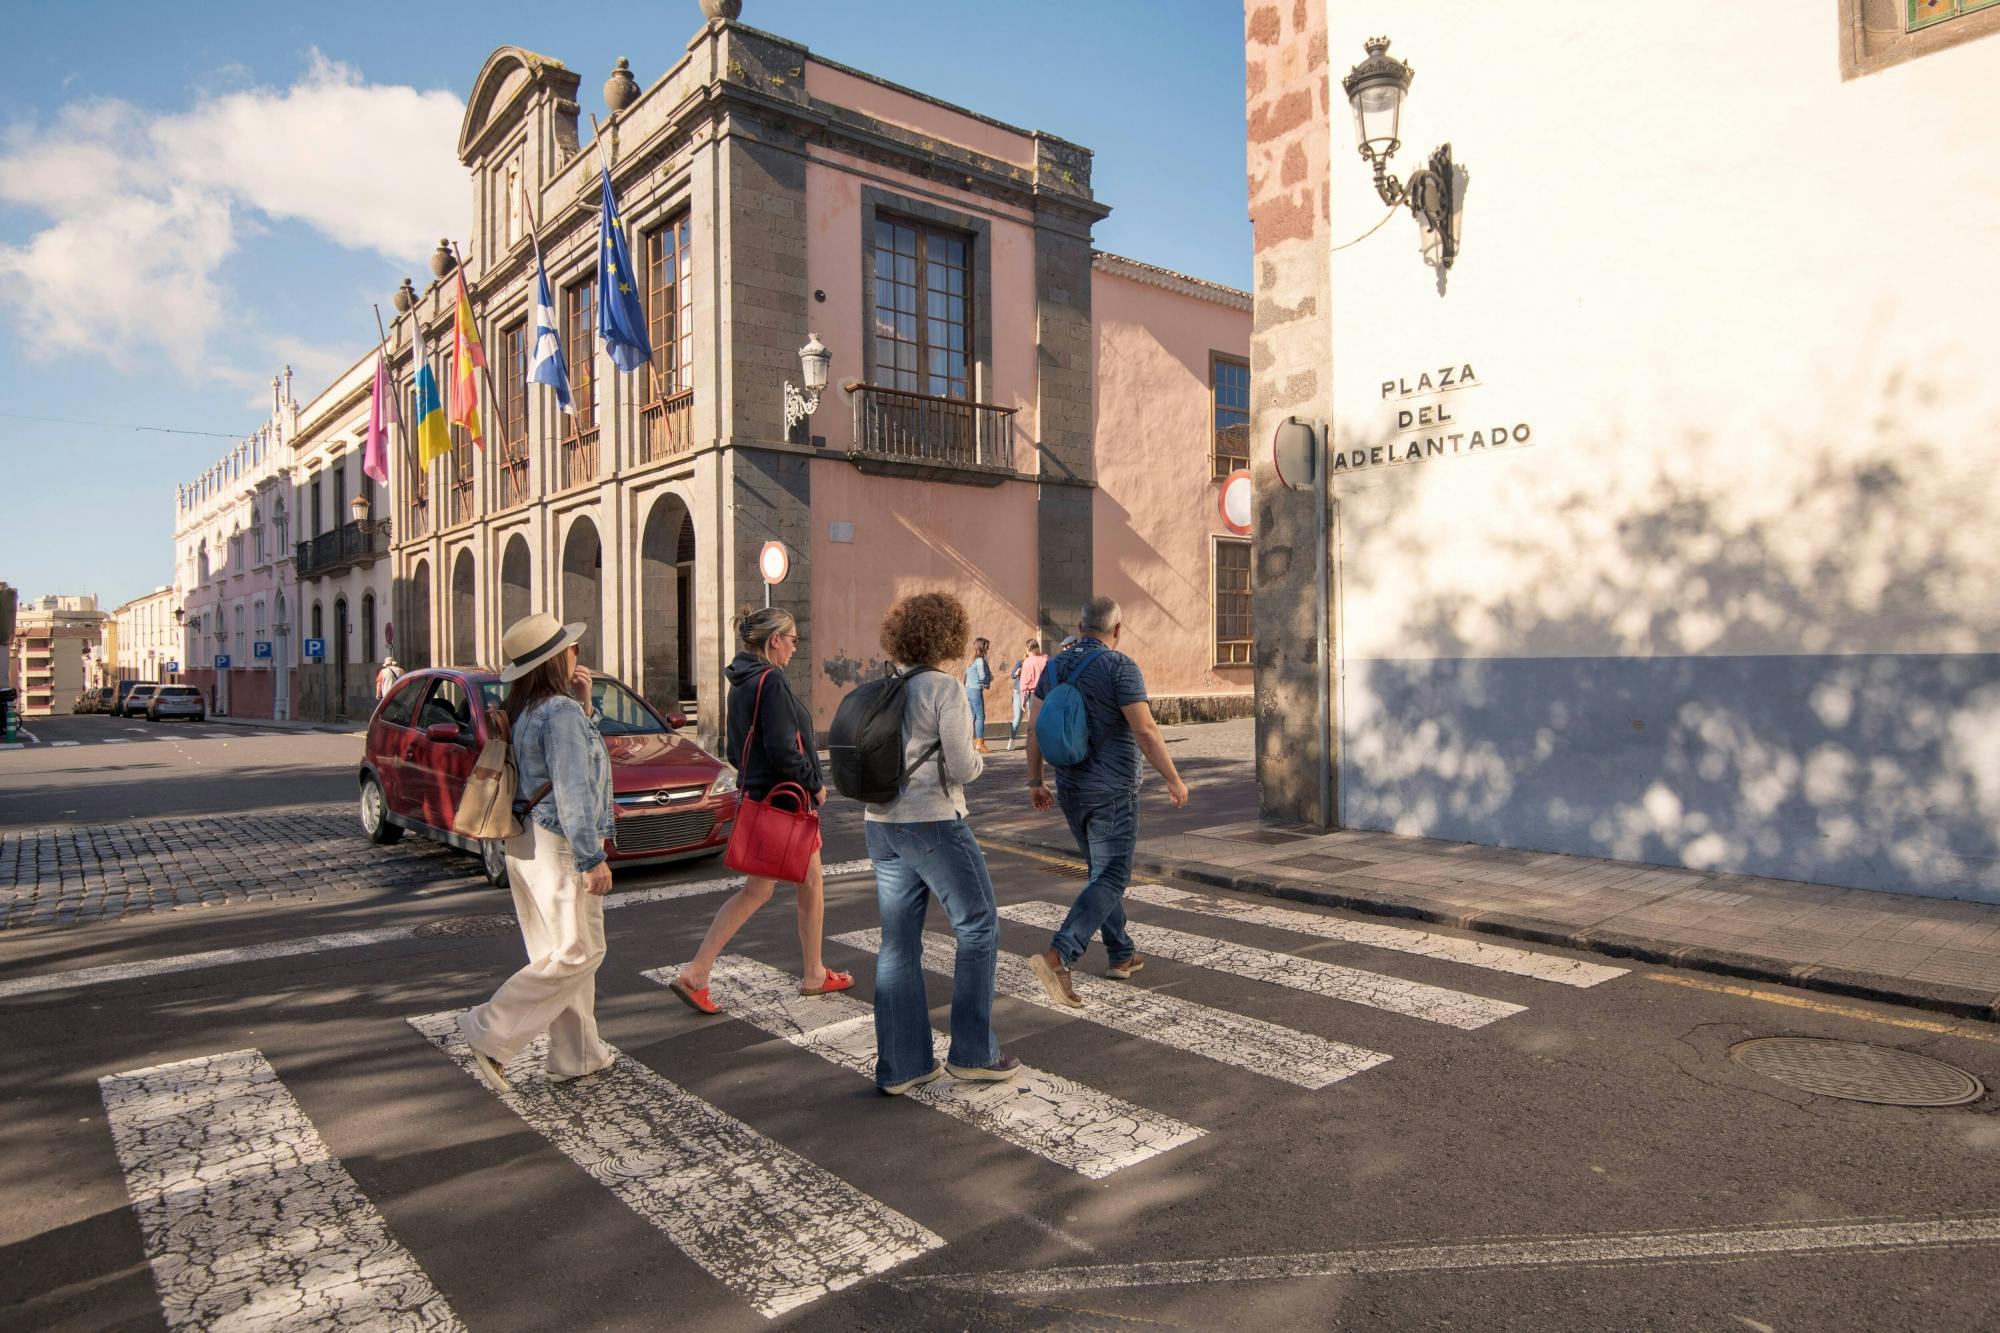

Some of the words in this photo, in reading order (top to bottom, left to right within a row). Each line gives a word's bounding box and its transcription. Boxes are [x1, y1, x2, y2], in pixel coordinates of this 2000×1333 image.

[1381, 363, 1476, 399] PLAZA
[1398, 403, 1452, 429] DEL
[1334, 423, 1530, 469] ADELANTADO
[257, 643, 268, 655] P
[309, 641, 321, 655] P
[167, 662, 175, 671] P
[217, 656, 225, 666] P
